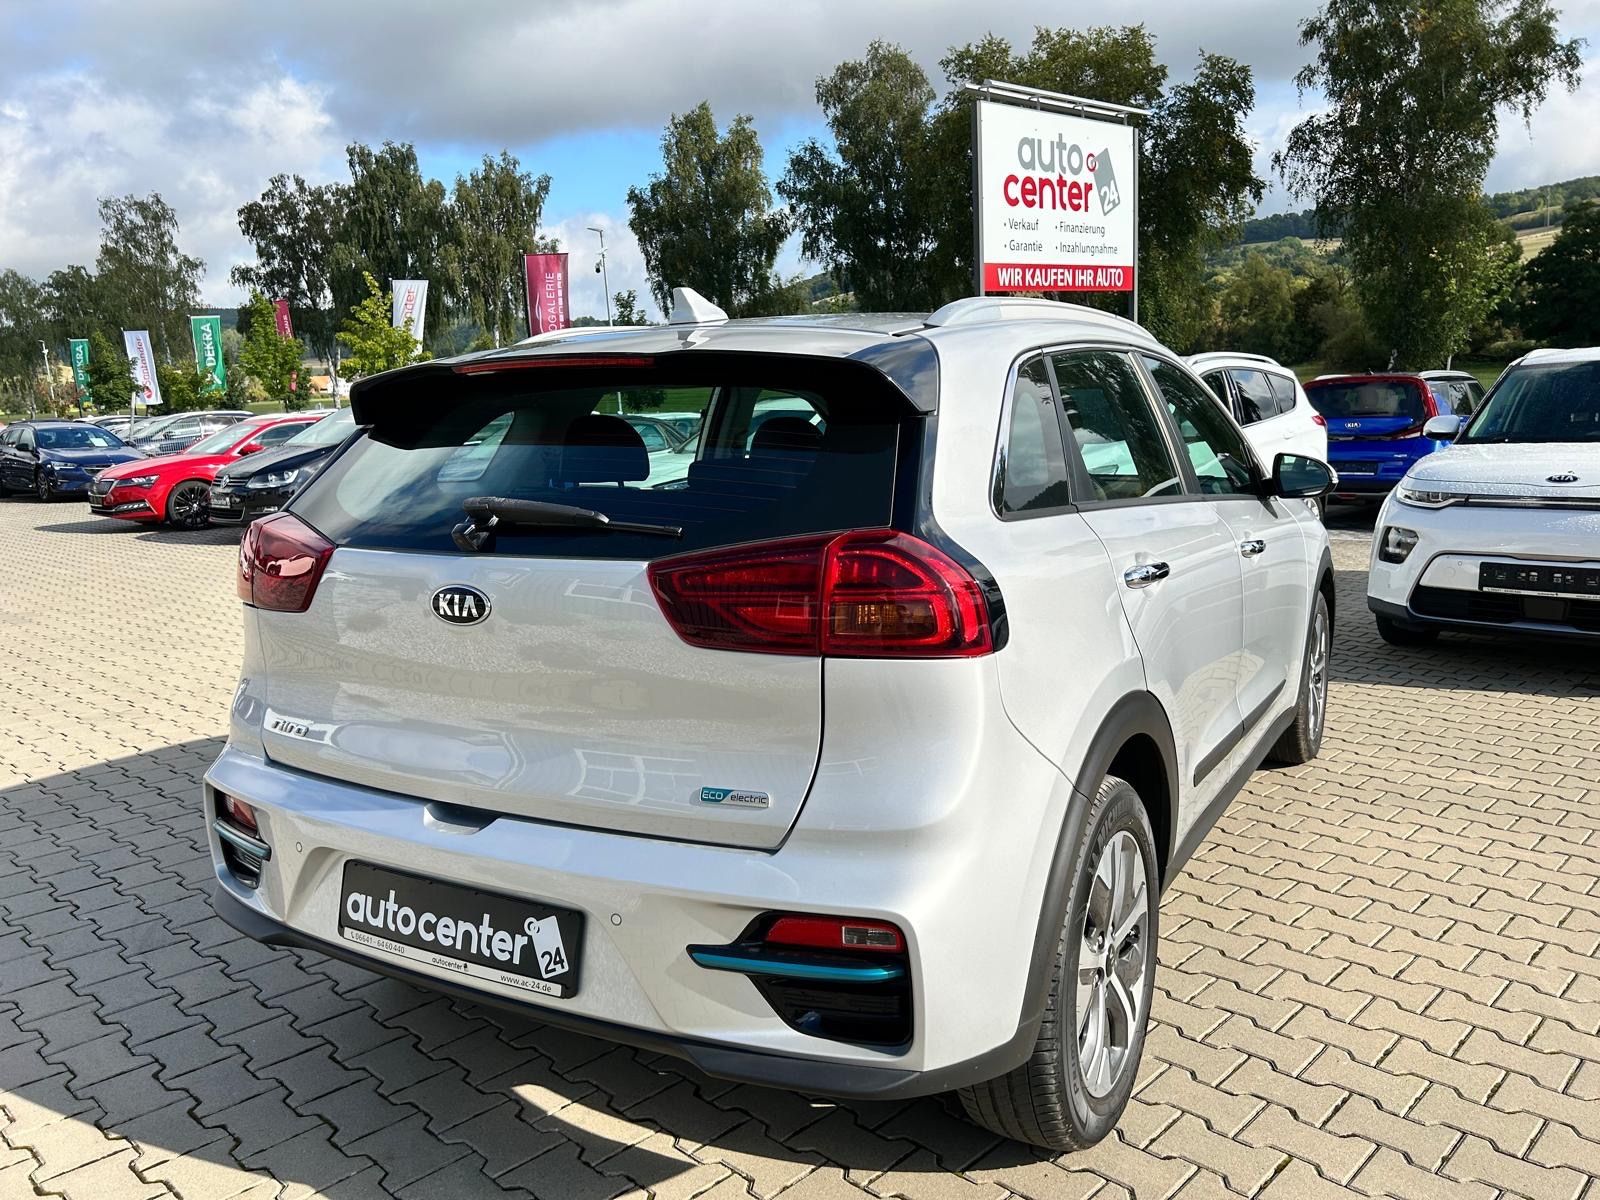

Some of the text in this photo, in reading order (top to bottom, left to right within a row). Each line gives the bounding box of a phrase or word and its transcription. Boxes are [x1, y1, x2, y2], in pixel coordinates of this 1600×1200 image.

[1018, 133, 1083, 176] auto
[1004, 173, 1093, 212] center
[1100, 179, 1118, 214] 24
[1009, 218, 1039, 231] Verkauf
[1060, 221, 1105, 237] Finanzierung
[1009, 240, 1043, 252] Garantie
[1060, 242, 1118, 256] Inzahlungnahme
[998, 268, 1124, 287] WIR KAUFEN IHR AUTO
[200, 322, 216, 367] DEKRA
[136, 336, 151, 386] Santander
[438, 593, 479, 617] KIA
[702, 790, 767, 804] ECO electric
[346, 890, 528, 965] autocenter
[432, 957, 463, 970] autocenter
[541, 946, 565, 975] 24
[501, 975, 552, 992] www.ac-24.de
